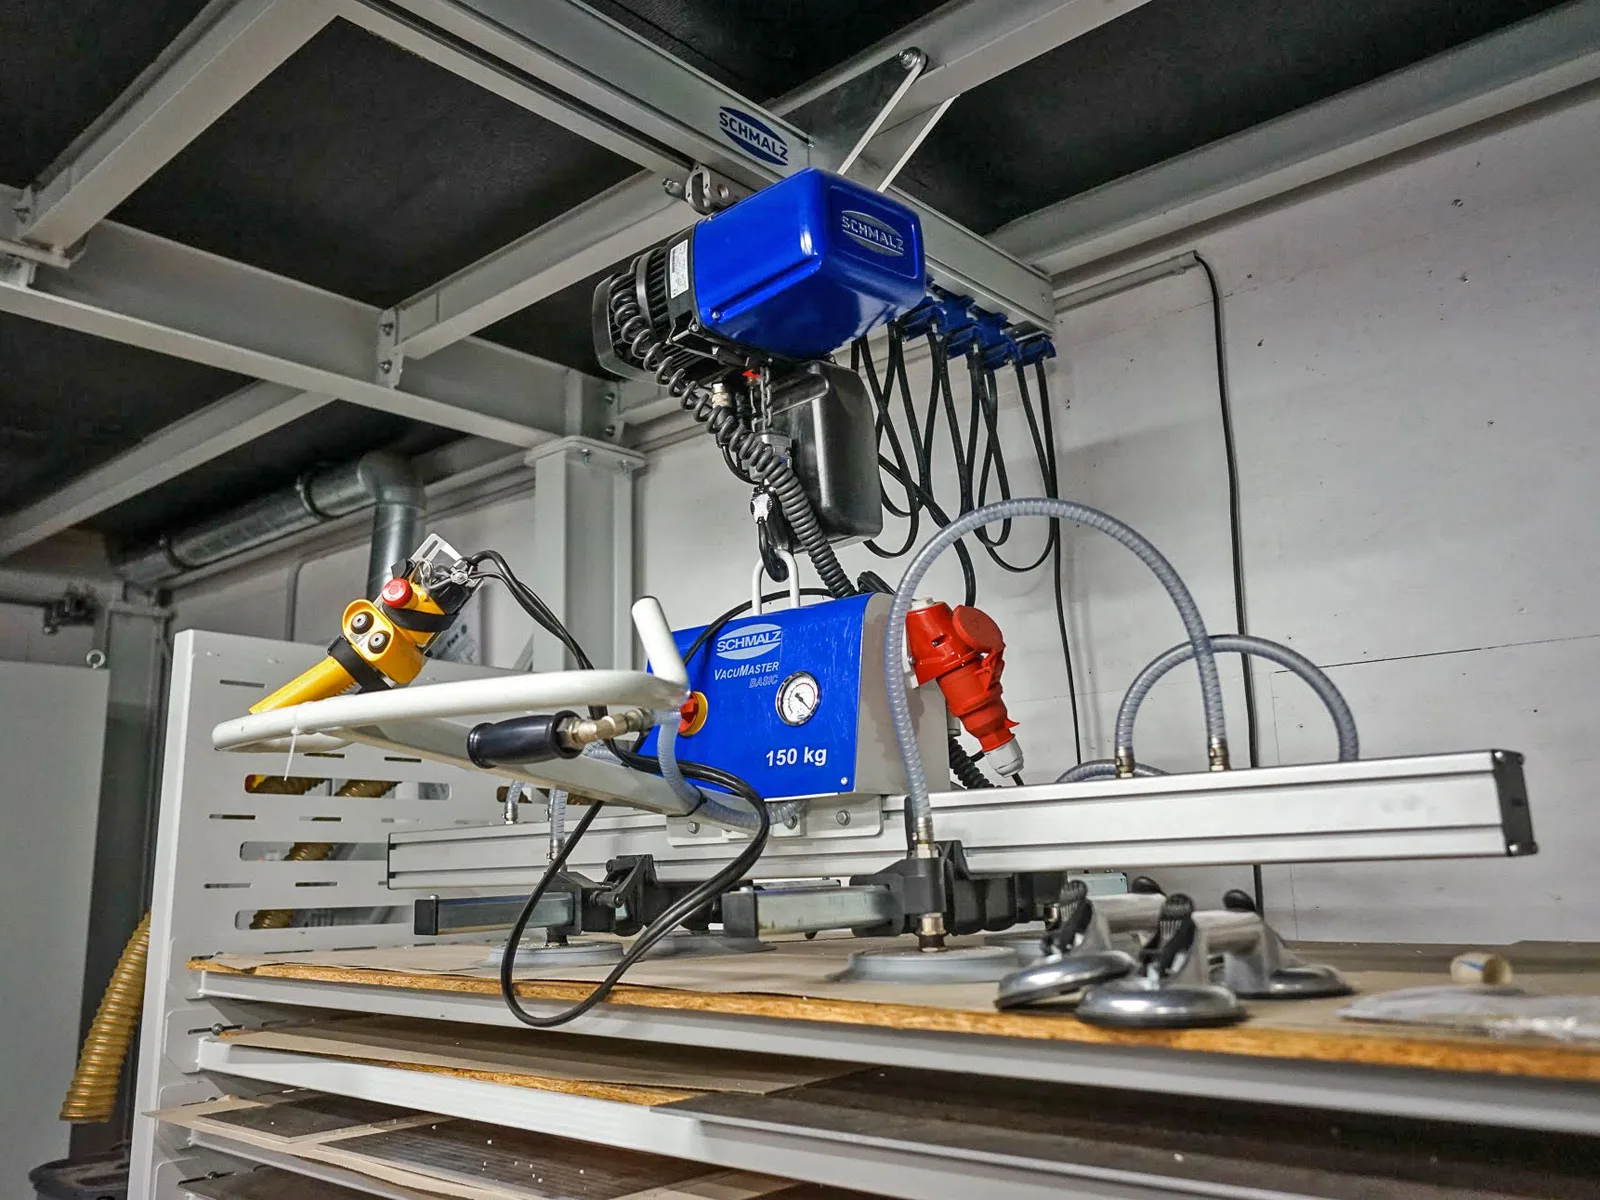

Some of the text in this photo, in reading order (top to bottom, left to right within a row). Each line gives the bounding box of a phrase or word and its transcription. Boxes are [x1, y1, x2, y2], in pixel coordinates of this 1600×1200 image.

[719, 111, 789, 162] SCHMALZ
[841, 215, 904, 252] SCHMALZ
[716, 630, 782, 653] SCHMALZ
[748, 673, 779, 689] BASIC
[765, 746, 827, 767] 150 kg
